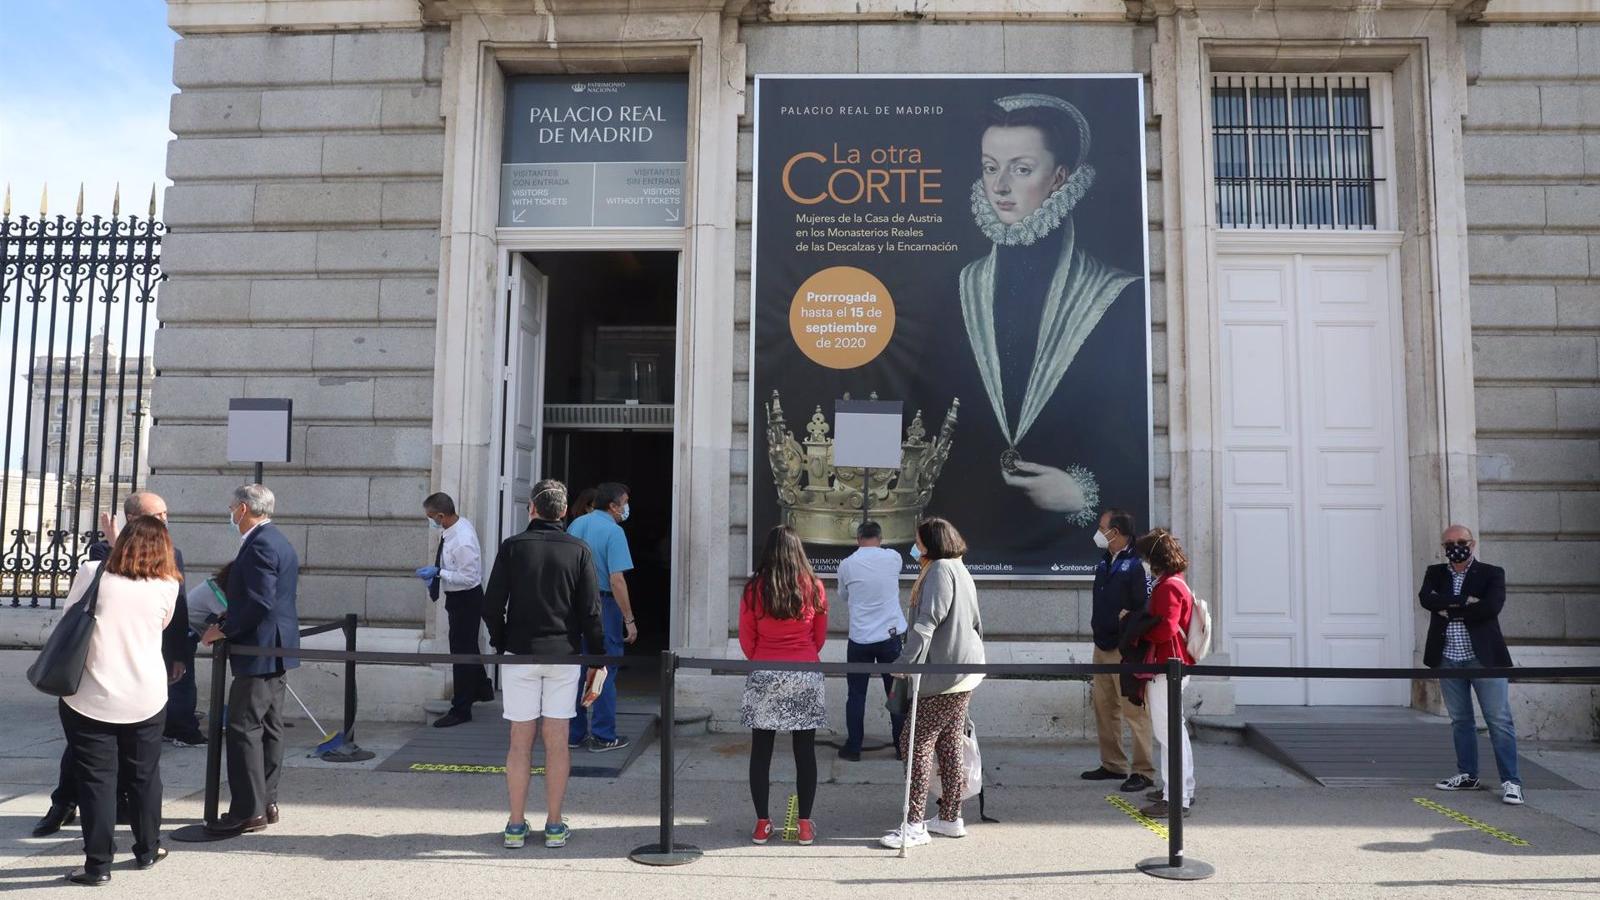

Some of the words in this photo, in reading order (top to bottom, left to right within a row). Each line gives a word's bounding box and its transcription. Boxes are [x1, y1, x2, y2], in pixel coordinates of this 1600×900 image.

[530, 106, 613, 123] PALACIO
[620, 106, 666, 122] REAL
[781, 106, 834, 115] PALACIO
[840, 106, 869, 115] REAL
[875, 106, 890, 115] DE
[896, 106, 944, 115] MADRID
[539, 127, 564, 144] DE
[570, 126, 653, 143] MADRID
[833, 142, 860, 164] La
[871, 144, 922, 164] otra
[513, 169, 559, 177] VISITANTES
[634, 168, 680, 176] VISITANTES
[513, 178, 530, 186] CON
[532, 178, 569, 186] ENTRADA
[643, 177, 680, 185] ENTRADA
[782, 151, 943, 205] CORTE
[796, 214, 835, 225] Mujeres
[837, 213, 851, 223] de
[853, 213, 862, 223] la
[865, 213, 889, 223] Casa
[891, 213, 905, 223] de
[907, 213, 942, 223] Austria
[796, 229, 808, 237] en
[811, 228, 825, 237] los
[828, 227, 888, 237] Monasterios
[891, 227, 923, 237] Reales
[796, 242, 808, 251] de
[811, 242, 824, 251] las
[827, 242, 875, 251] Descalzas
[877, 244, 883, 253] y
[886, 242, 894, 251] la
[897, 241, 958, 251] Encarnación
[807, 291, 877, 304] Prorrogada
[801, 307, 833, 317] hasta
[836, 307, 847, 317] el
[850, 307, 864, 317] 15
[867, 307, 882, 317] de
[806, 322, 877, 334] septiembre
[816, 338, 831, 348] de
[834, 338, 866, 348] 2020
